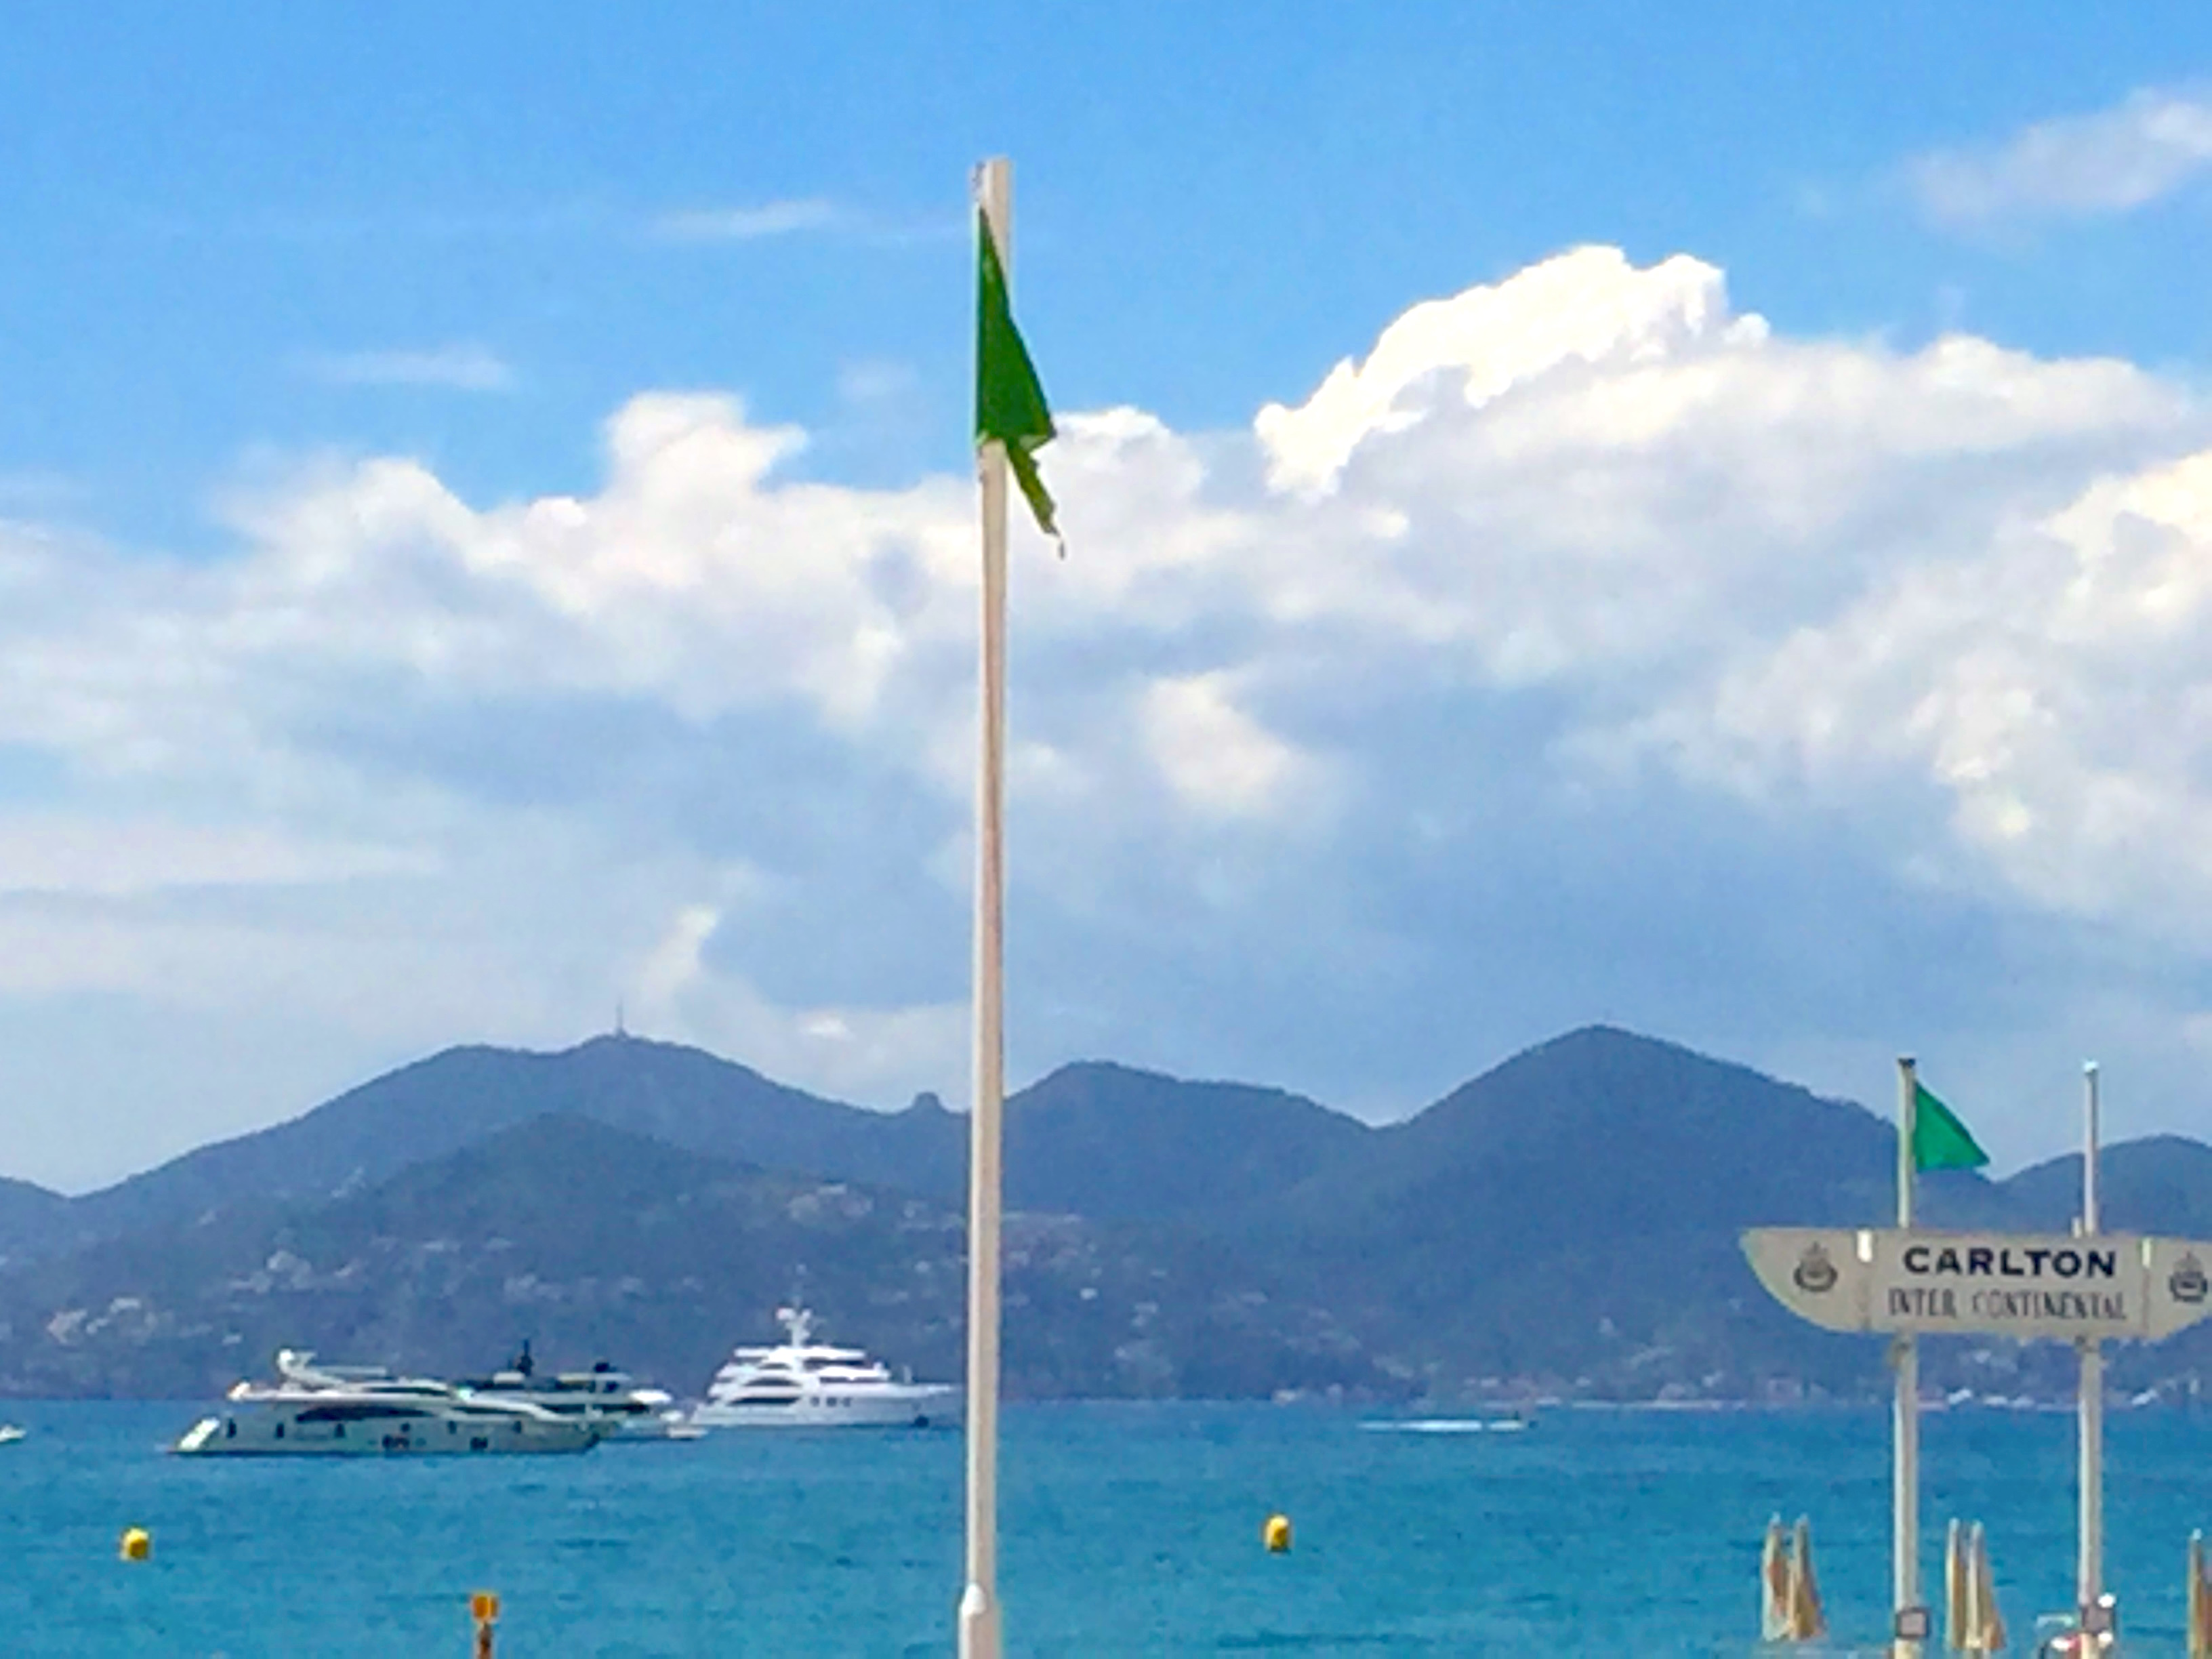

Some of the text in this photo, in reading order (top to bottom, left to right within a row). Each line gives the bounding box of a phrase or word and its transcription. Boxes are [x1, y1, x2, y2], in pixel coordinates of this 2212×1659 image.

[1903, 1246, 2116, 1278] CARLTON
[1889, 1288, 2127, 1320] INTER CONTINENTAL
